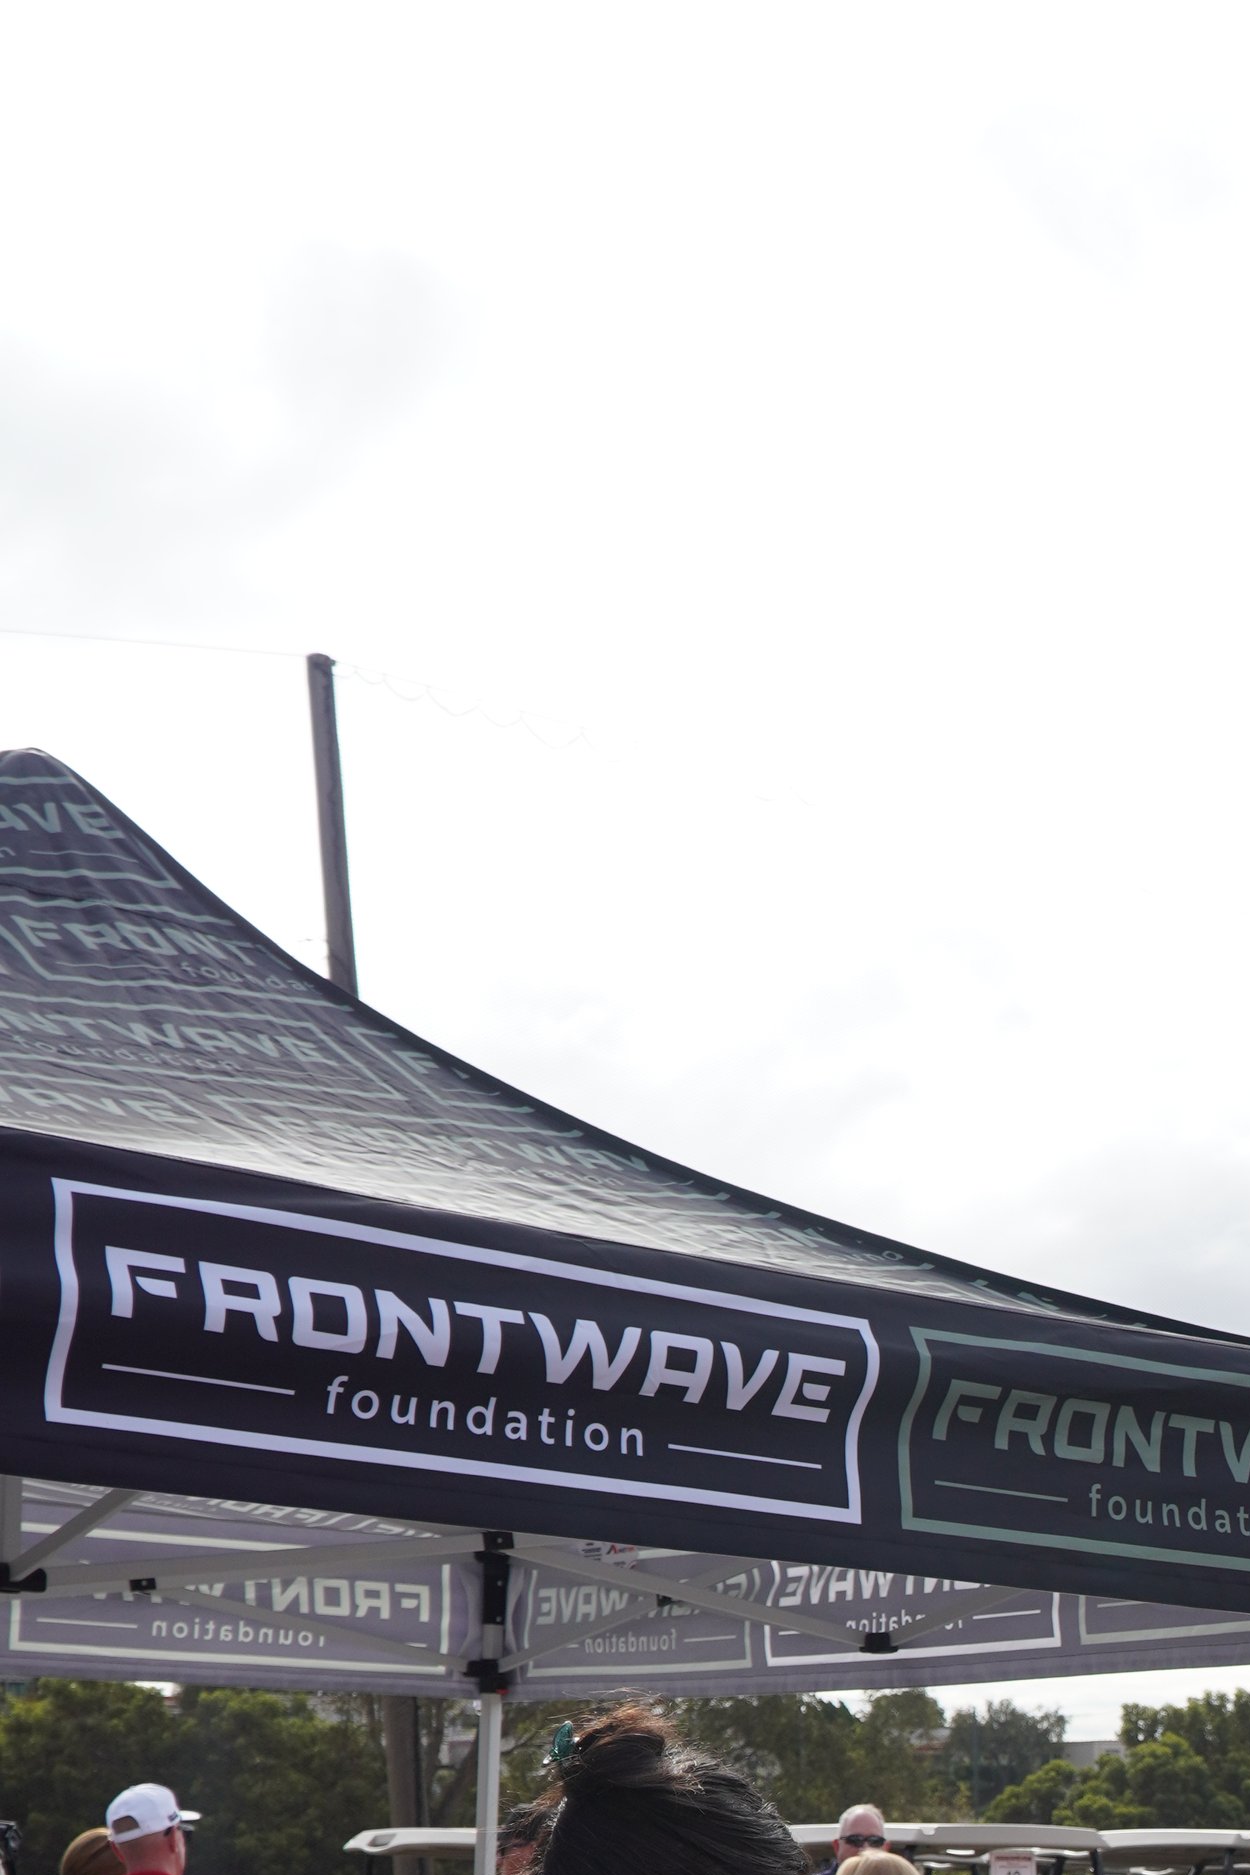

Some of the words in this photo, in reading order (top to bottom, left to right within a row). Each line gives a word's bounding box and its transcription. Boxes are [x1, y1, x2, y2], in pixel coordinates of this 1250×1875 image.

[10, 914, 293, 972] FRONT
[104, 1245, 847, 1424] FRONTWAVE
[326, 1375, 645, 1457] foundation
